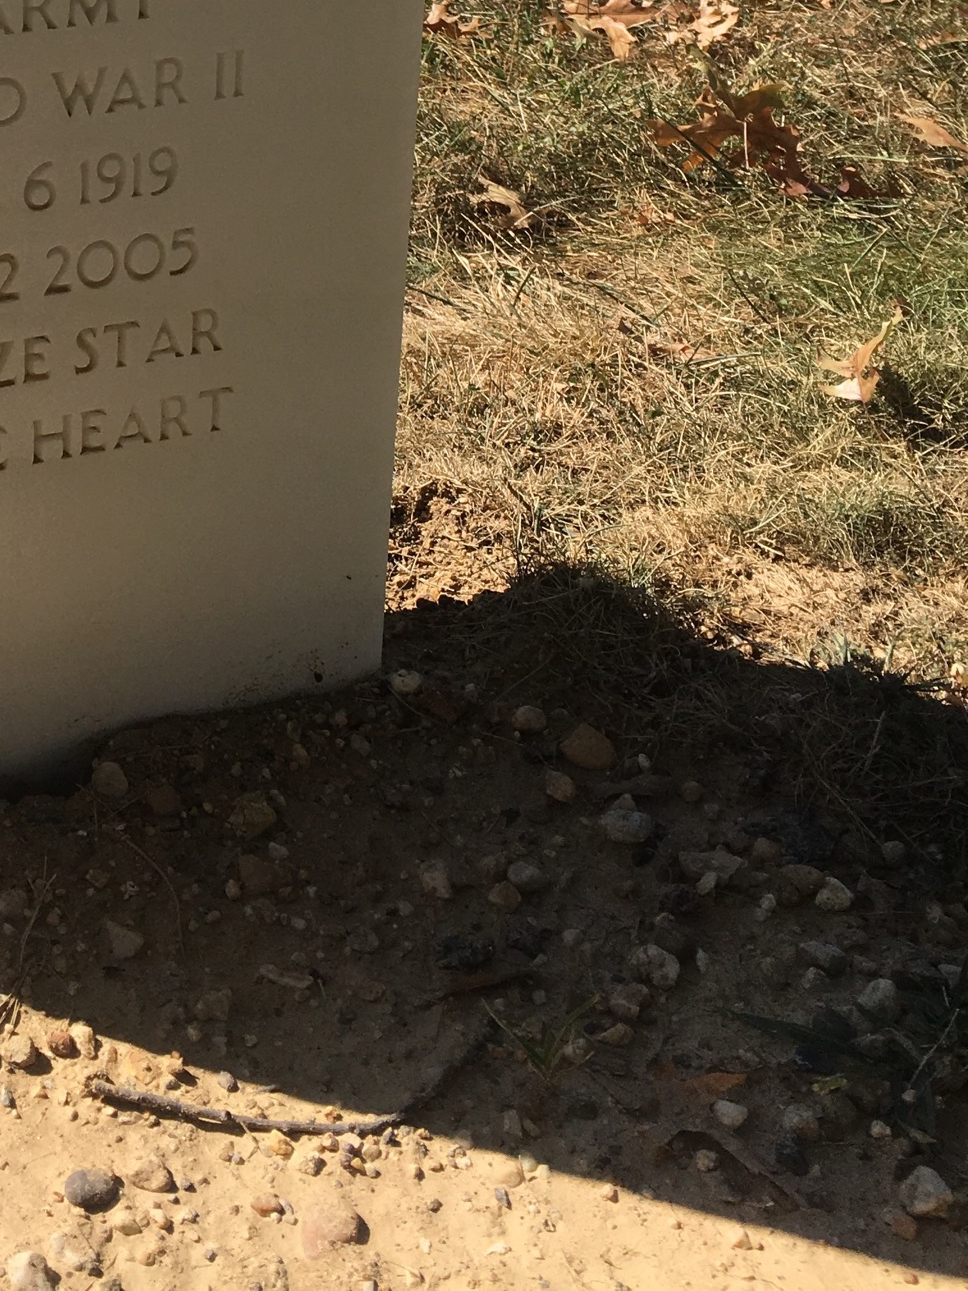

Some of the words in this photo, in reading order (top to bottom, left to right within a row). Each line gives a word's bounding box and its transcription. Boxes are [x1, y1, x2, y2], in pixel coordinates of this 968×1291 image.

[51, 57, 188, 118] WAR
[214, 50, 246, 101] II
[23, 161, 57, 212] 6
[78, 146, 178, 205] 1919
[43, 227, 200, 296] 2005
[73, 308, 223, 376] STAR
[32, 387, 234, 466] HEART
